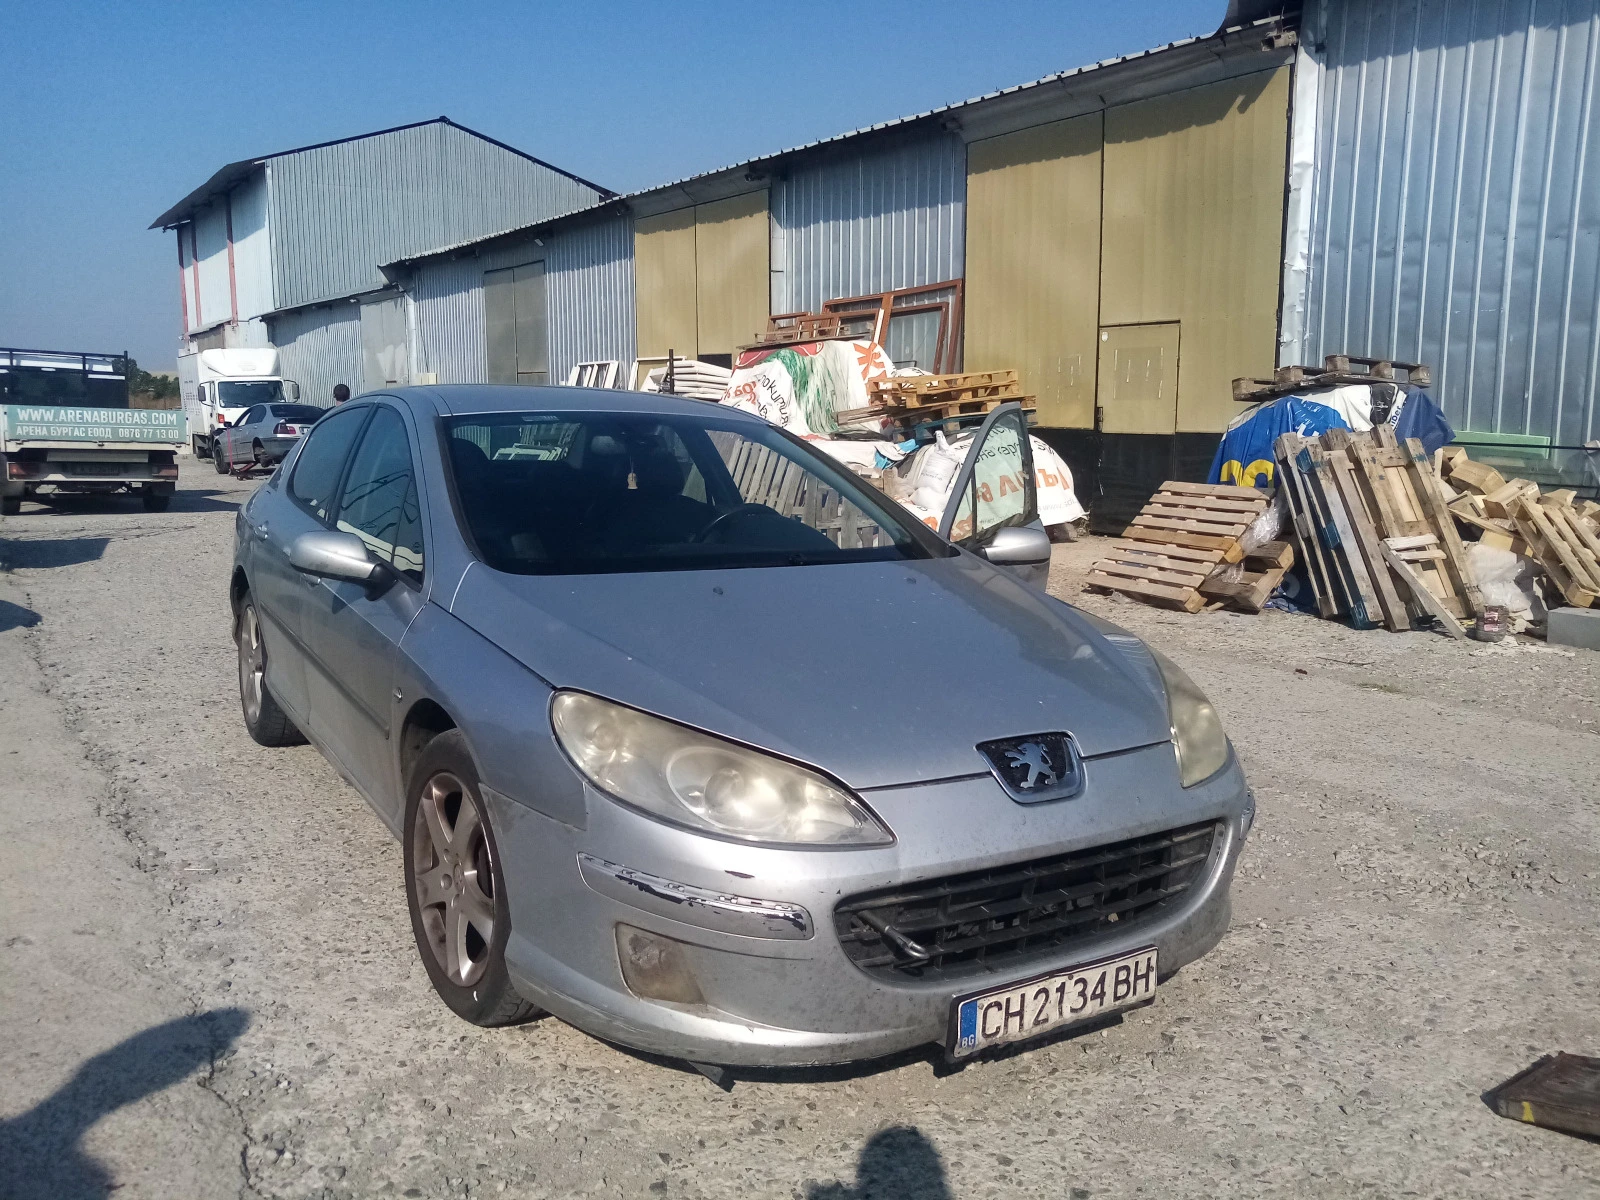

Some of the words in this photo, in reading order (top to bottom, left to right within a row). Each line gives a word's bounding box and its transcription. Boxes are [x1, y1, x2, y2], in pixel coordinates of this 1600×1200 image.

[17, 408, 177, 425] WWW.ARENABURGAS.COM
[16, 426, 48, 436] АРЕНА
[50, 426, 86, 437] БУРГАС
[88, 427, 112, 439] ЕООД
[118, 428, 140, 438] 0876
[143, 429, 153, 438] 77
[156, 429, 166, 439] 13
[168, 429, 179, 439] 00
[961, 1033, 975, 1048] BG
